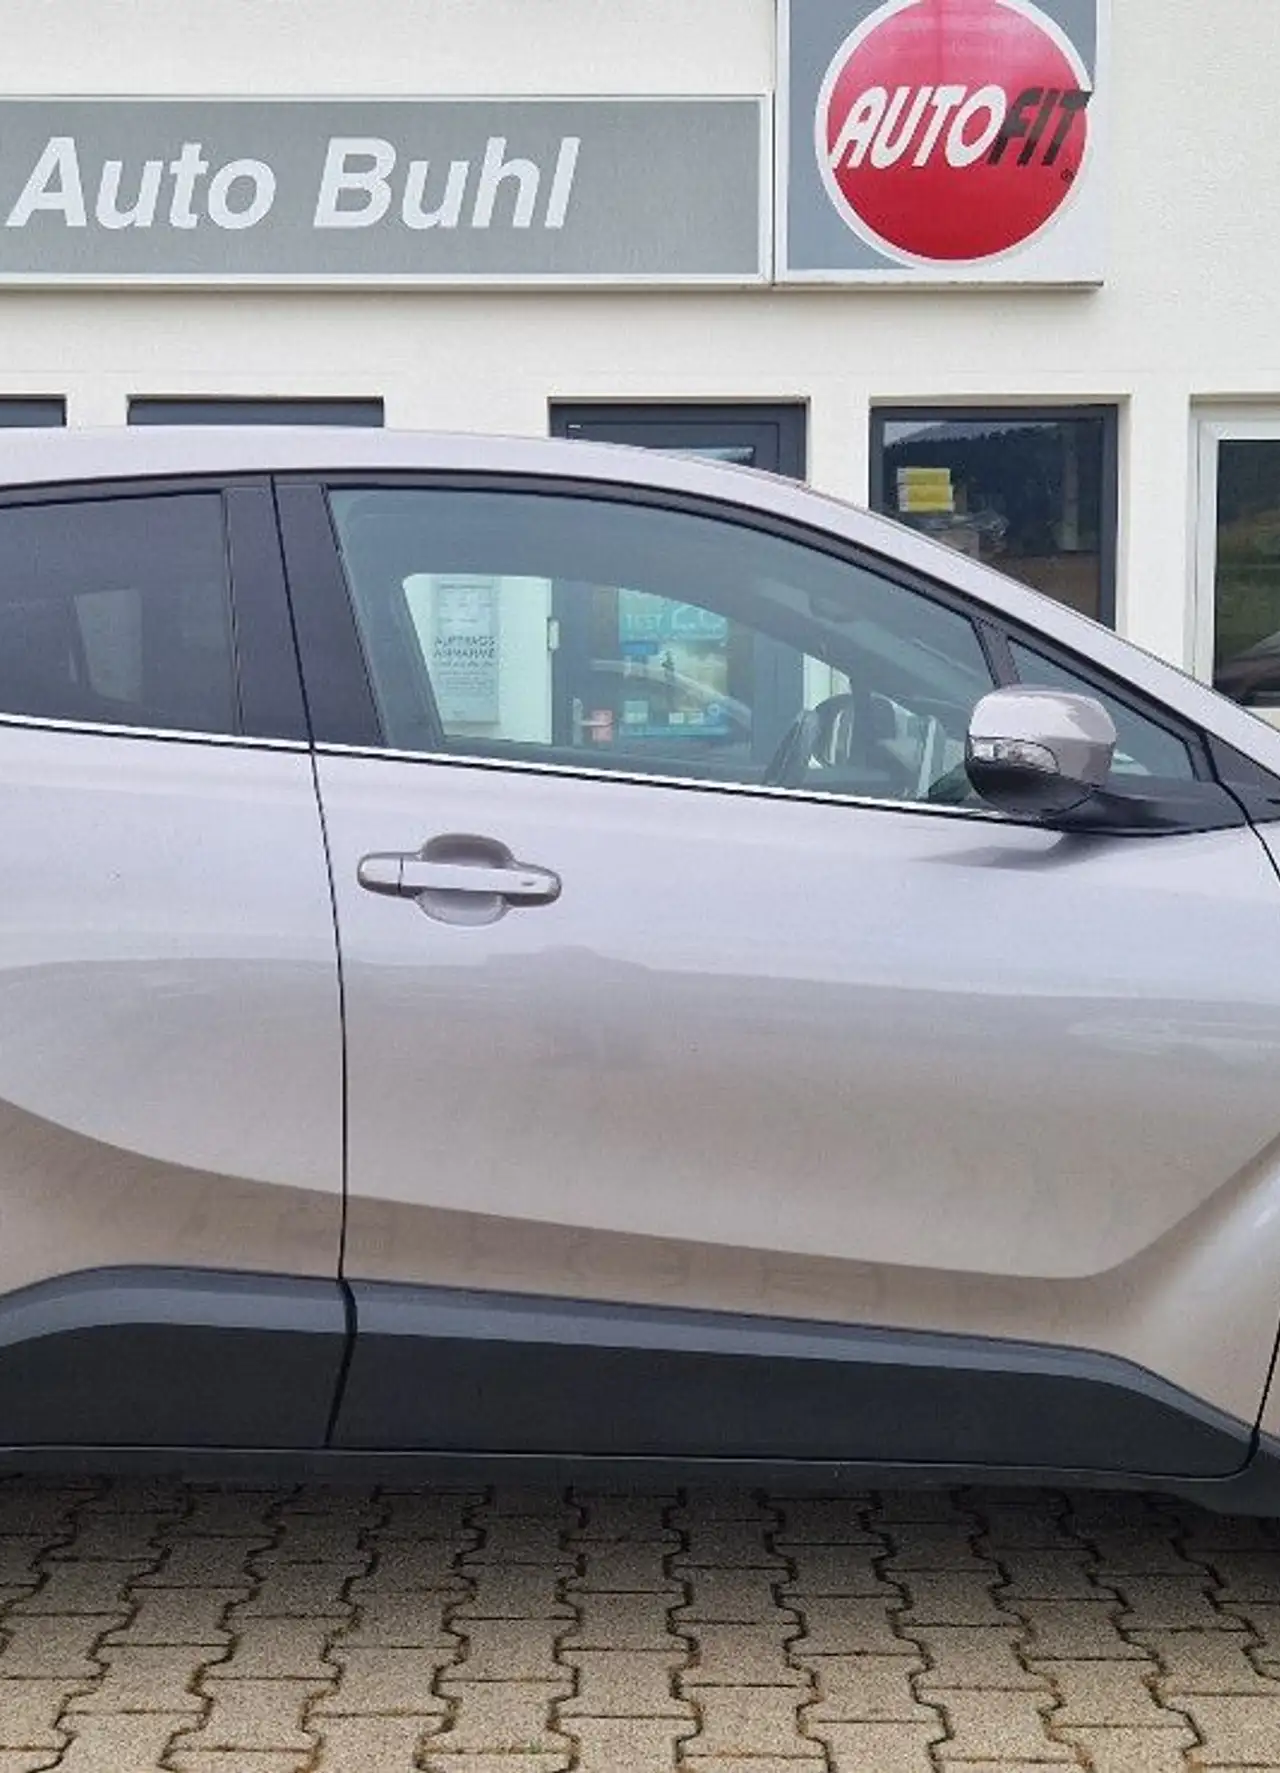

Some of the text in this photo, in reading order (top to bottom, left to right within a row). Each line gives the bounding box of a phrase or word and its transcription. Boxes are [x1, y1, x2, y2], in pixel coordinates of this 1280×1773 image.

[831, 84, 1093, 169] AUTOFIT
[5, 136, 581, 230] Auto Buhl
